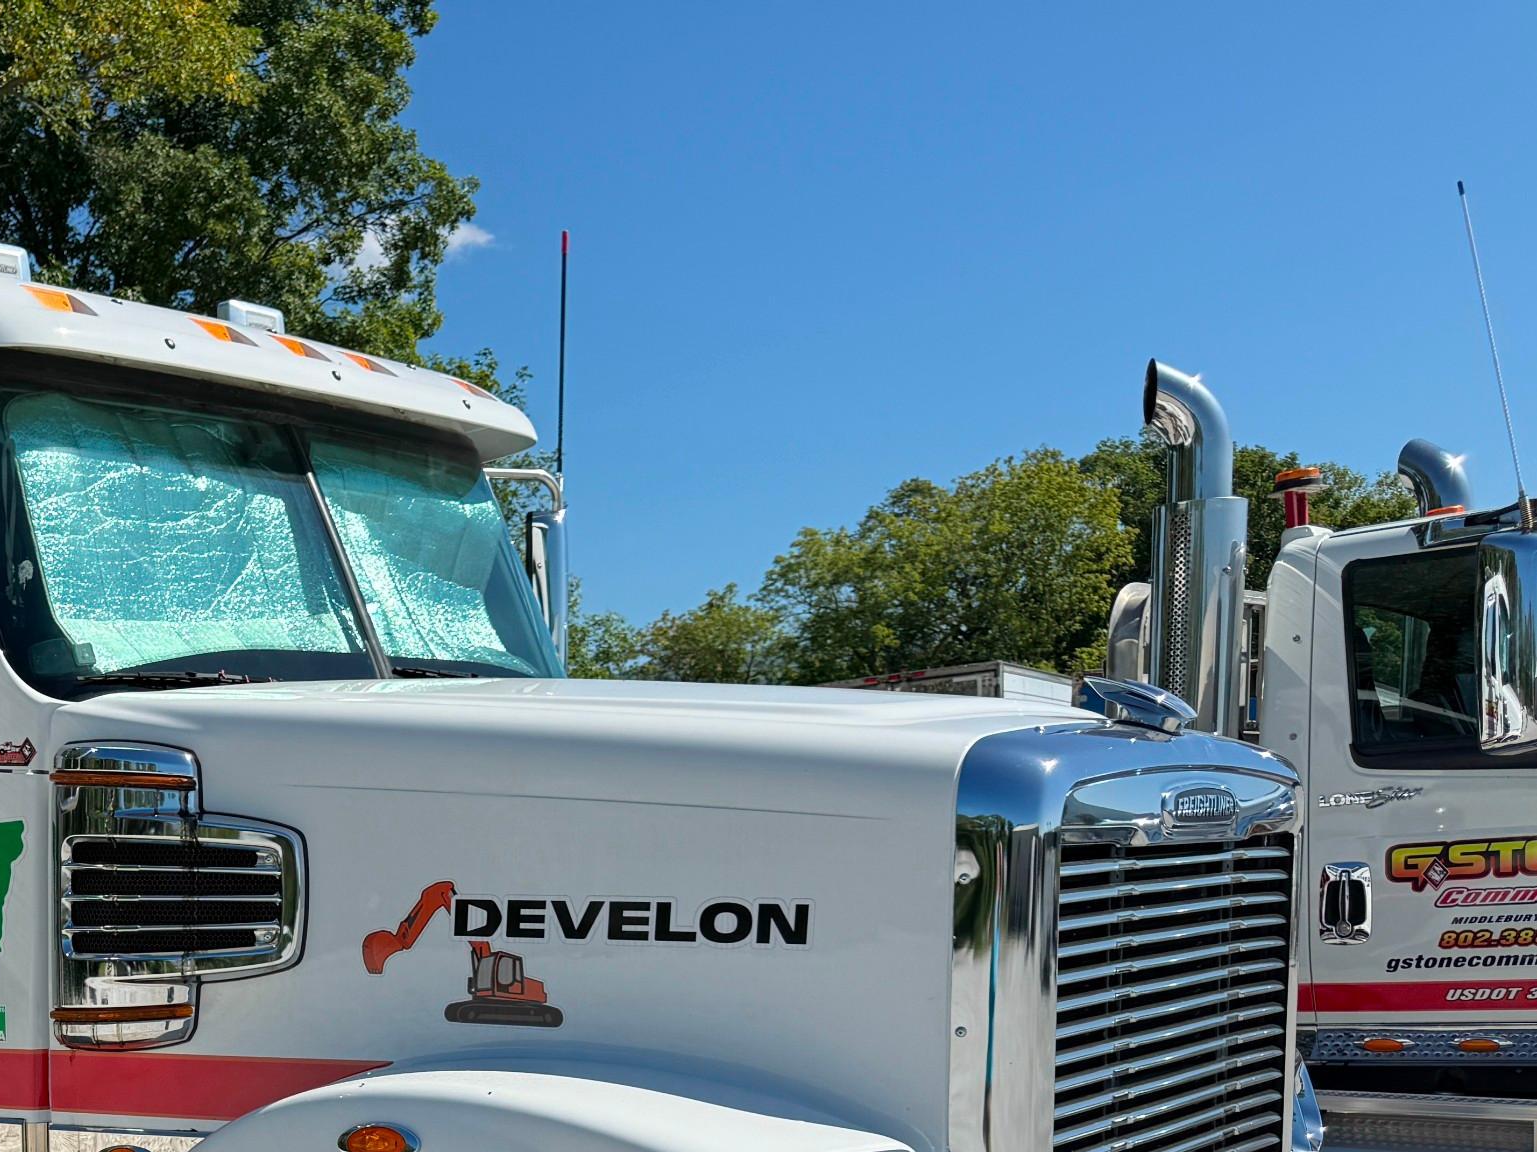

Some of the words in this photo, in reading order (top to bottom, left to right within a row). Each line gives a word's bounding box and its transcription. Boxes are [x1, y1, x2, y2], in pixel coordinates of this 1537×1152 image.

[1178, 794, 1234, 816] FREIGHTLINER
[454, 900, 810, 945] DEVELON
[1440, 929, 1537, 947] 802.38
[1446, 988, 1522, 1000] USDOT
